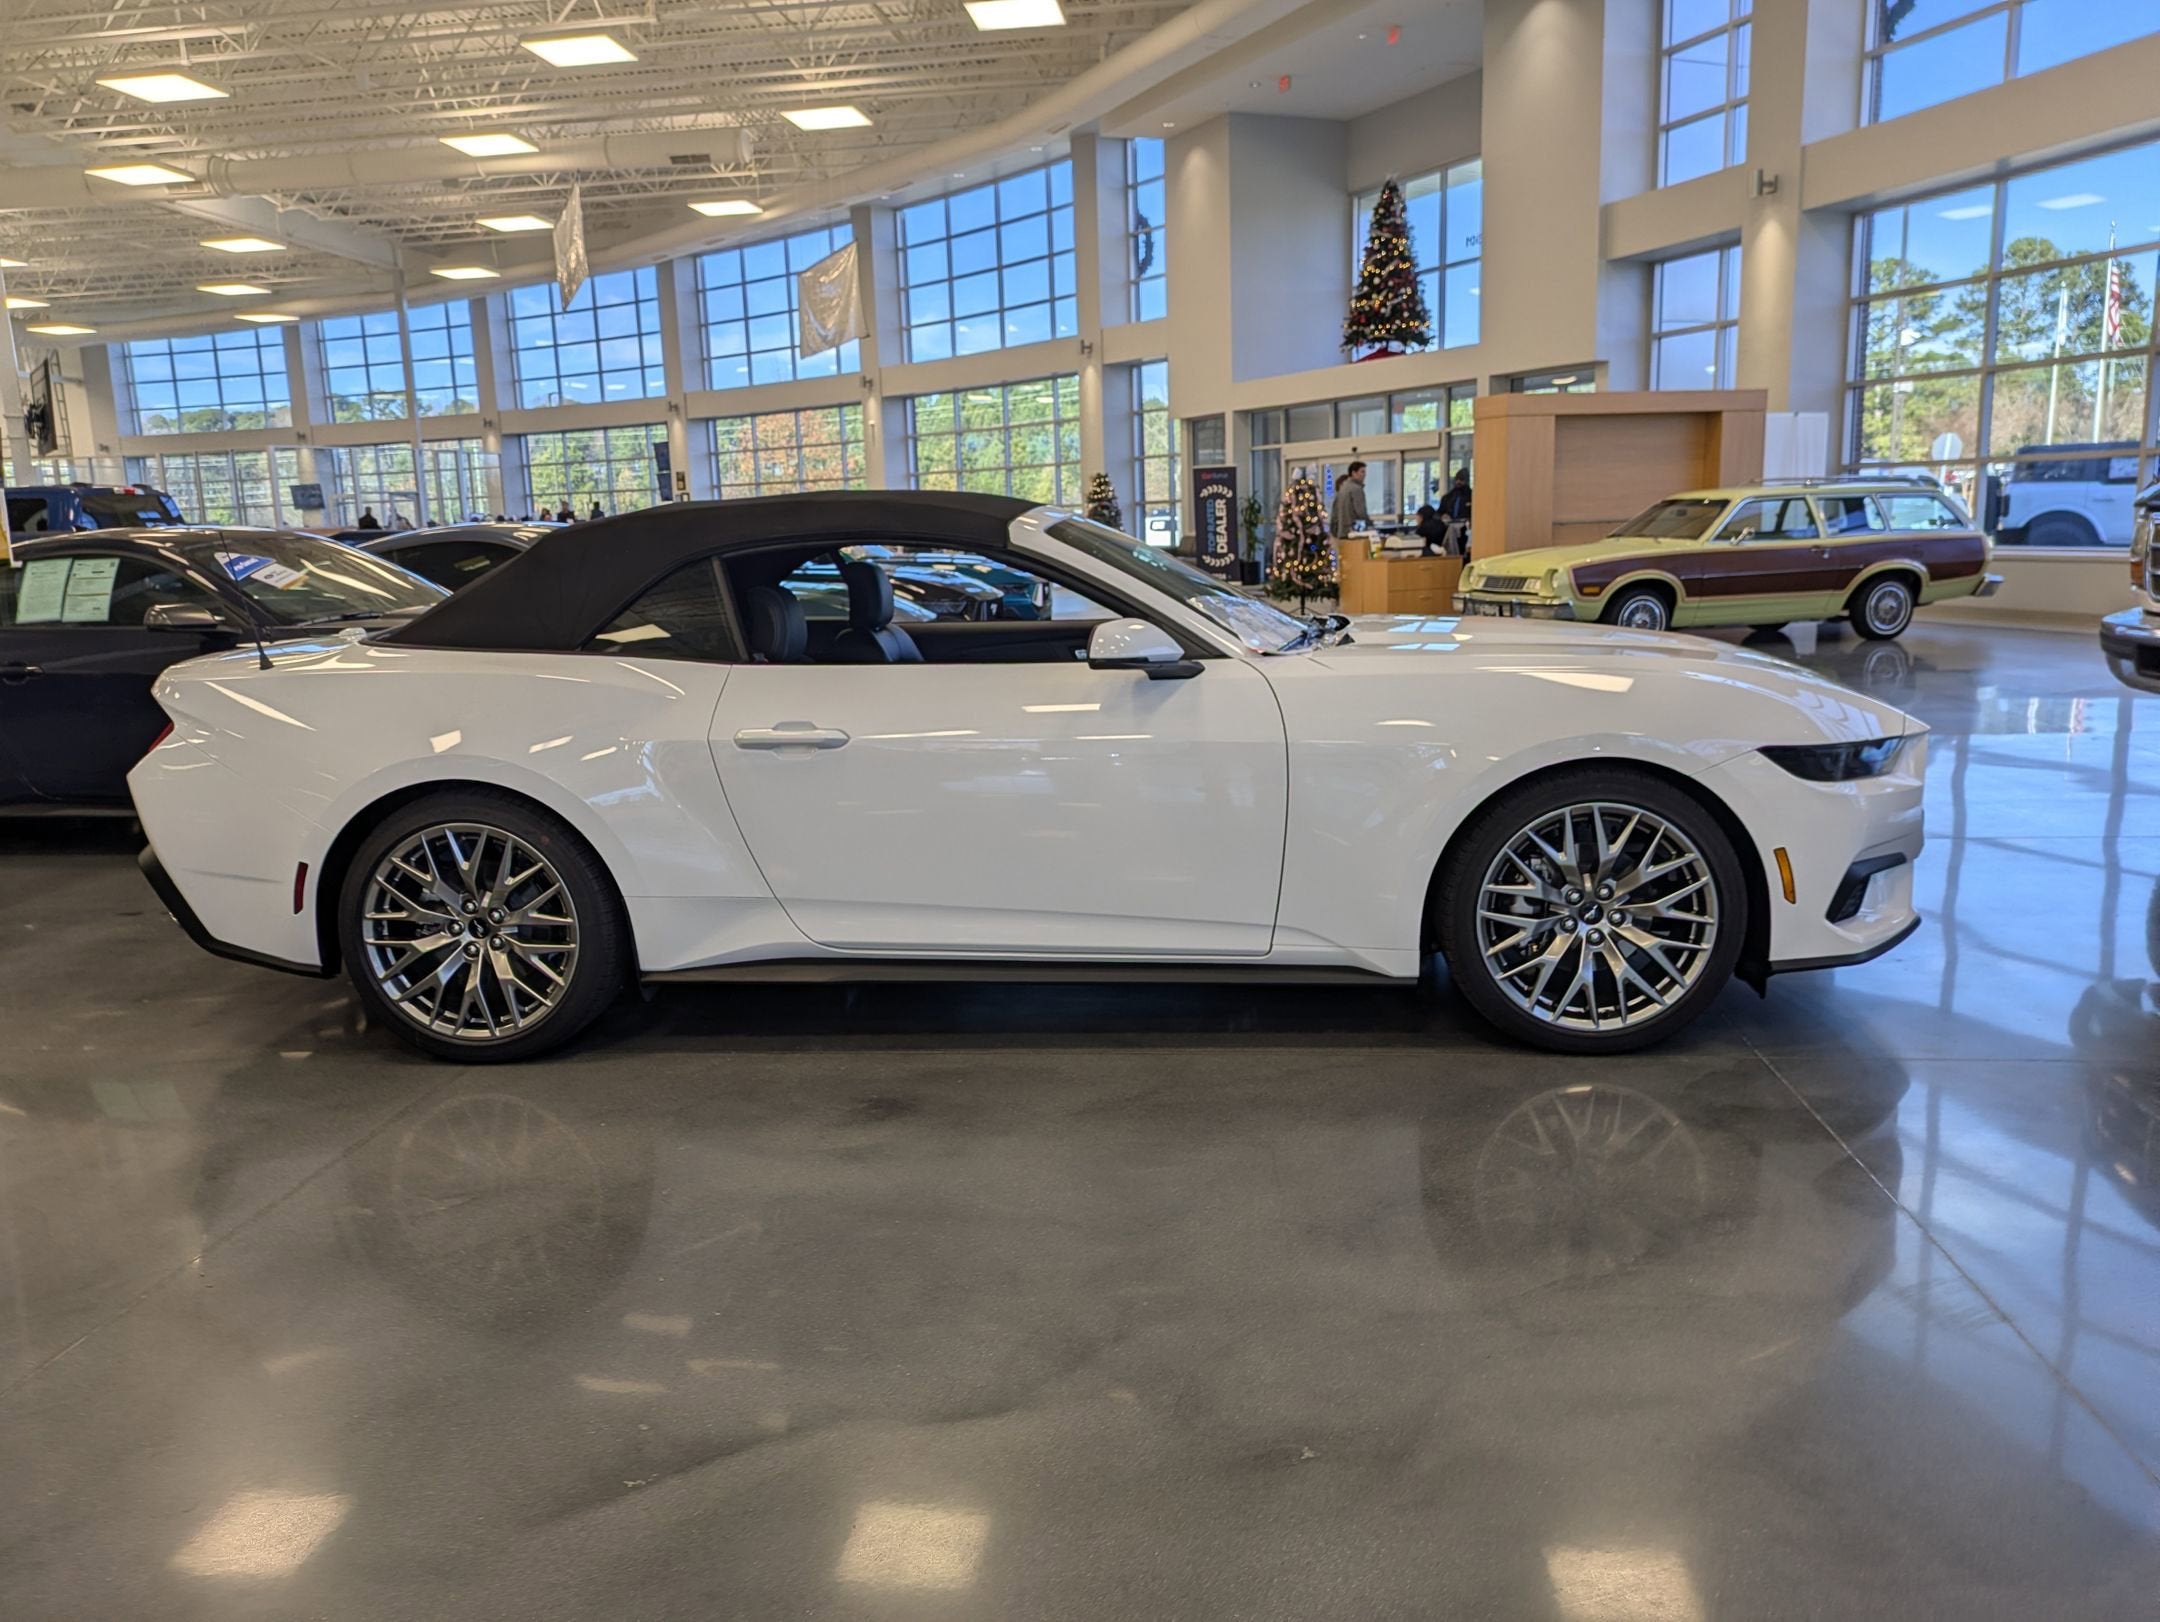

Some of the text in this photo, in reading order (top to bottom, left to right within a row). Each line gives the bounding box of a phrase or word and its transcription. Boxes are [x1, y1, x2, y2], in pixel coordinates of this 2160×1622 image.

[1206, 499, 1215, 553] TOP RATED
[1215, 498, 1228, 554] DEALER
